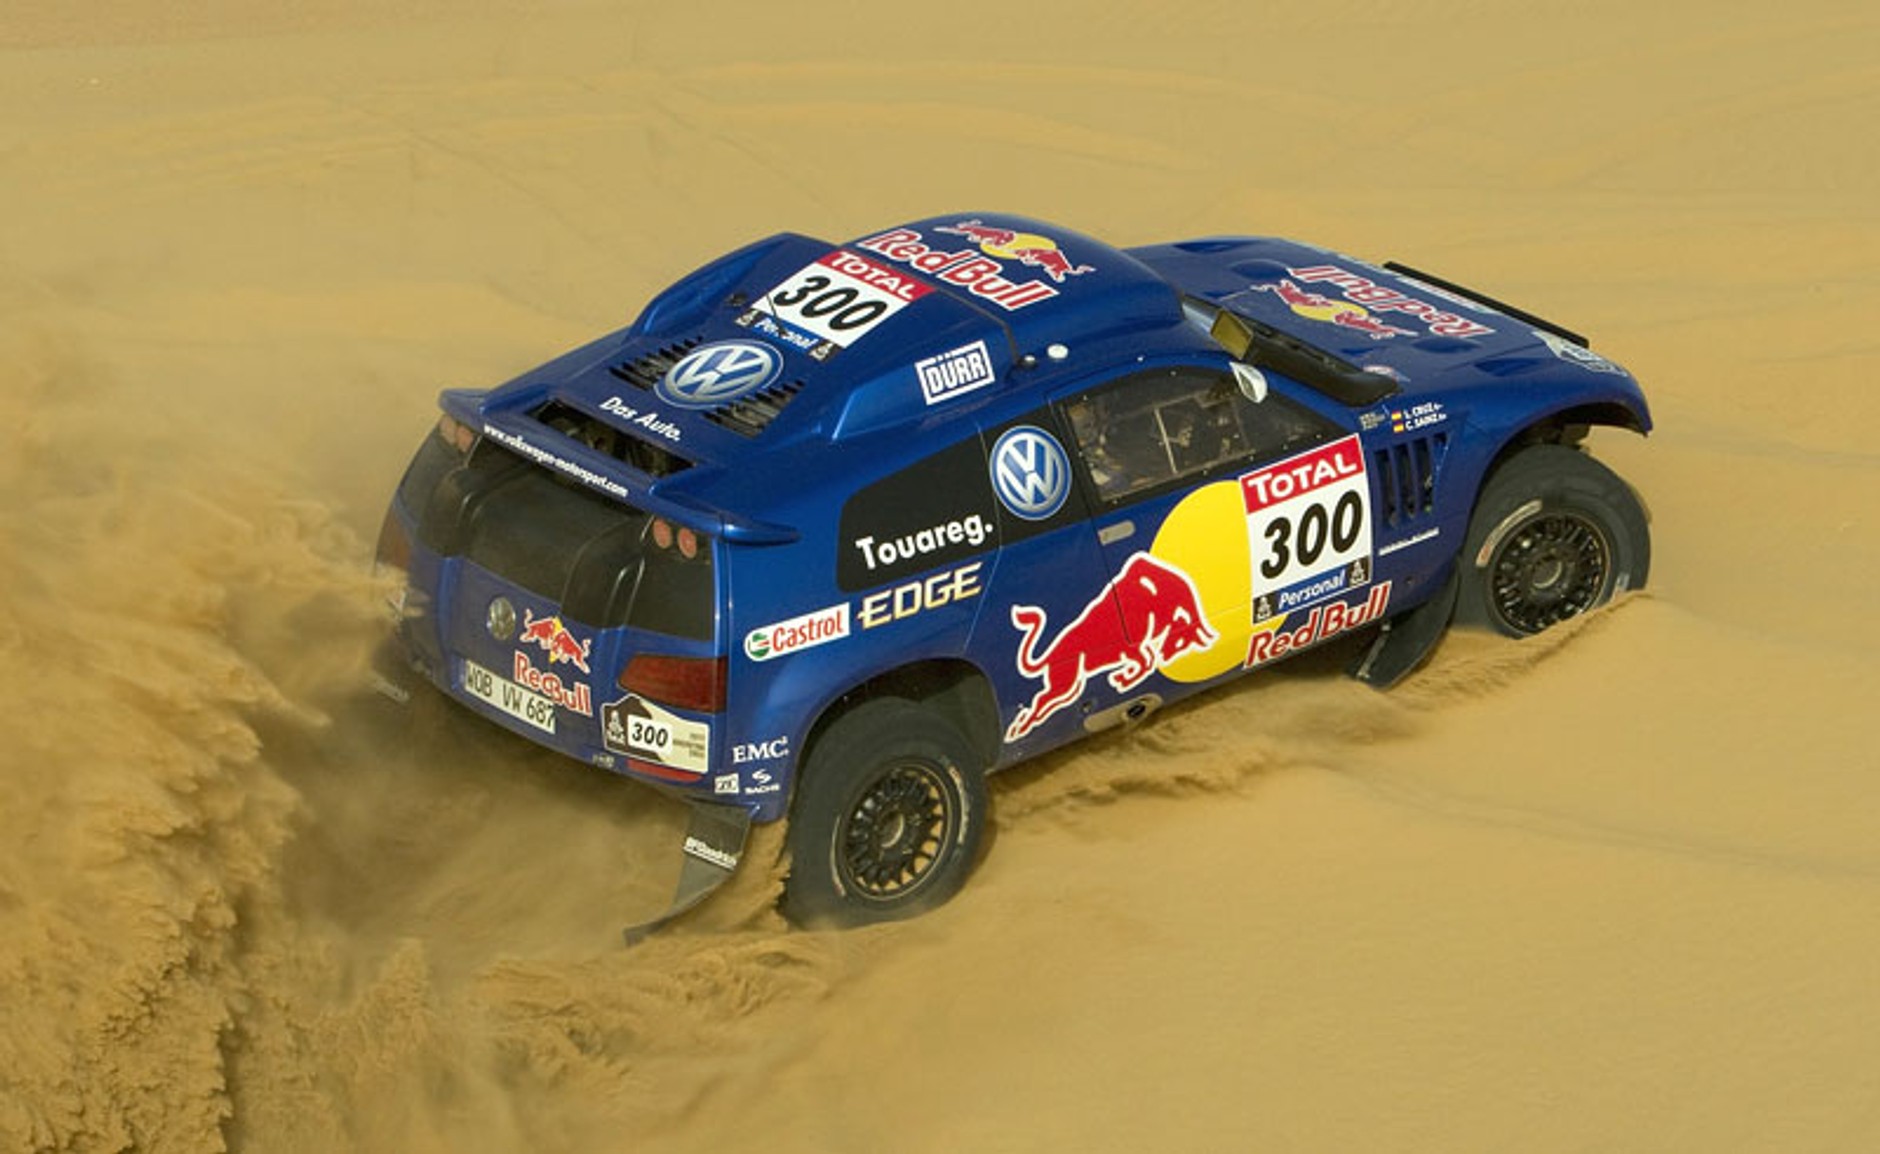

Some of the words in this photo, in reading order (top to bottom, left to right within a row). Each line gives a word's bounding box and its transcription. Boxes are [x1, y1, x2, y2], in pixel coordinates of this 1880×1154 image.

[831, 252, 917, 299] TOTAL
[857, 228, 979, 274] Red
[936, 257, 1060, 311] Bull
[774, 276, 888, 331] 300
[923, 350, 988, 396] DÜRR
[600, 396, 637, 420] Das
[635, 412, 681, 441] Auto.
[1248, 452, 1358, 504] TOTAL
[856, 514, 993, 570] Touareg.
[1261, 490, 1363, 580] 300
[857, 562, 983, 630] EDGE
[1278, 570, 1345, 609] Personal
[772, 609, 843, 652] Castrol
[1242, 606, 1321, 671] Red
[1317, 580, 1392, 642] Bull
[632, 721, 669, 748] 300
